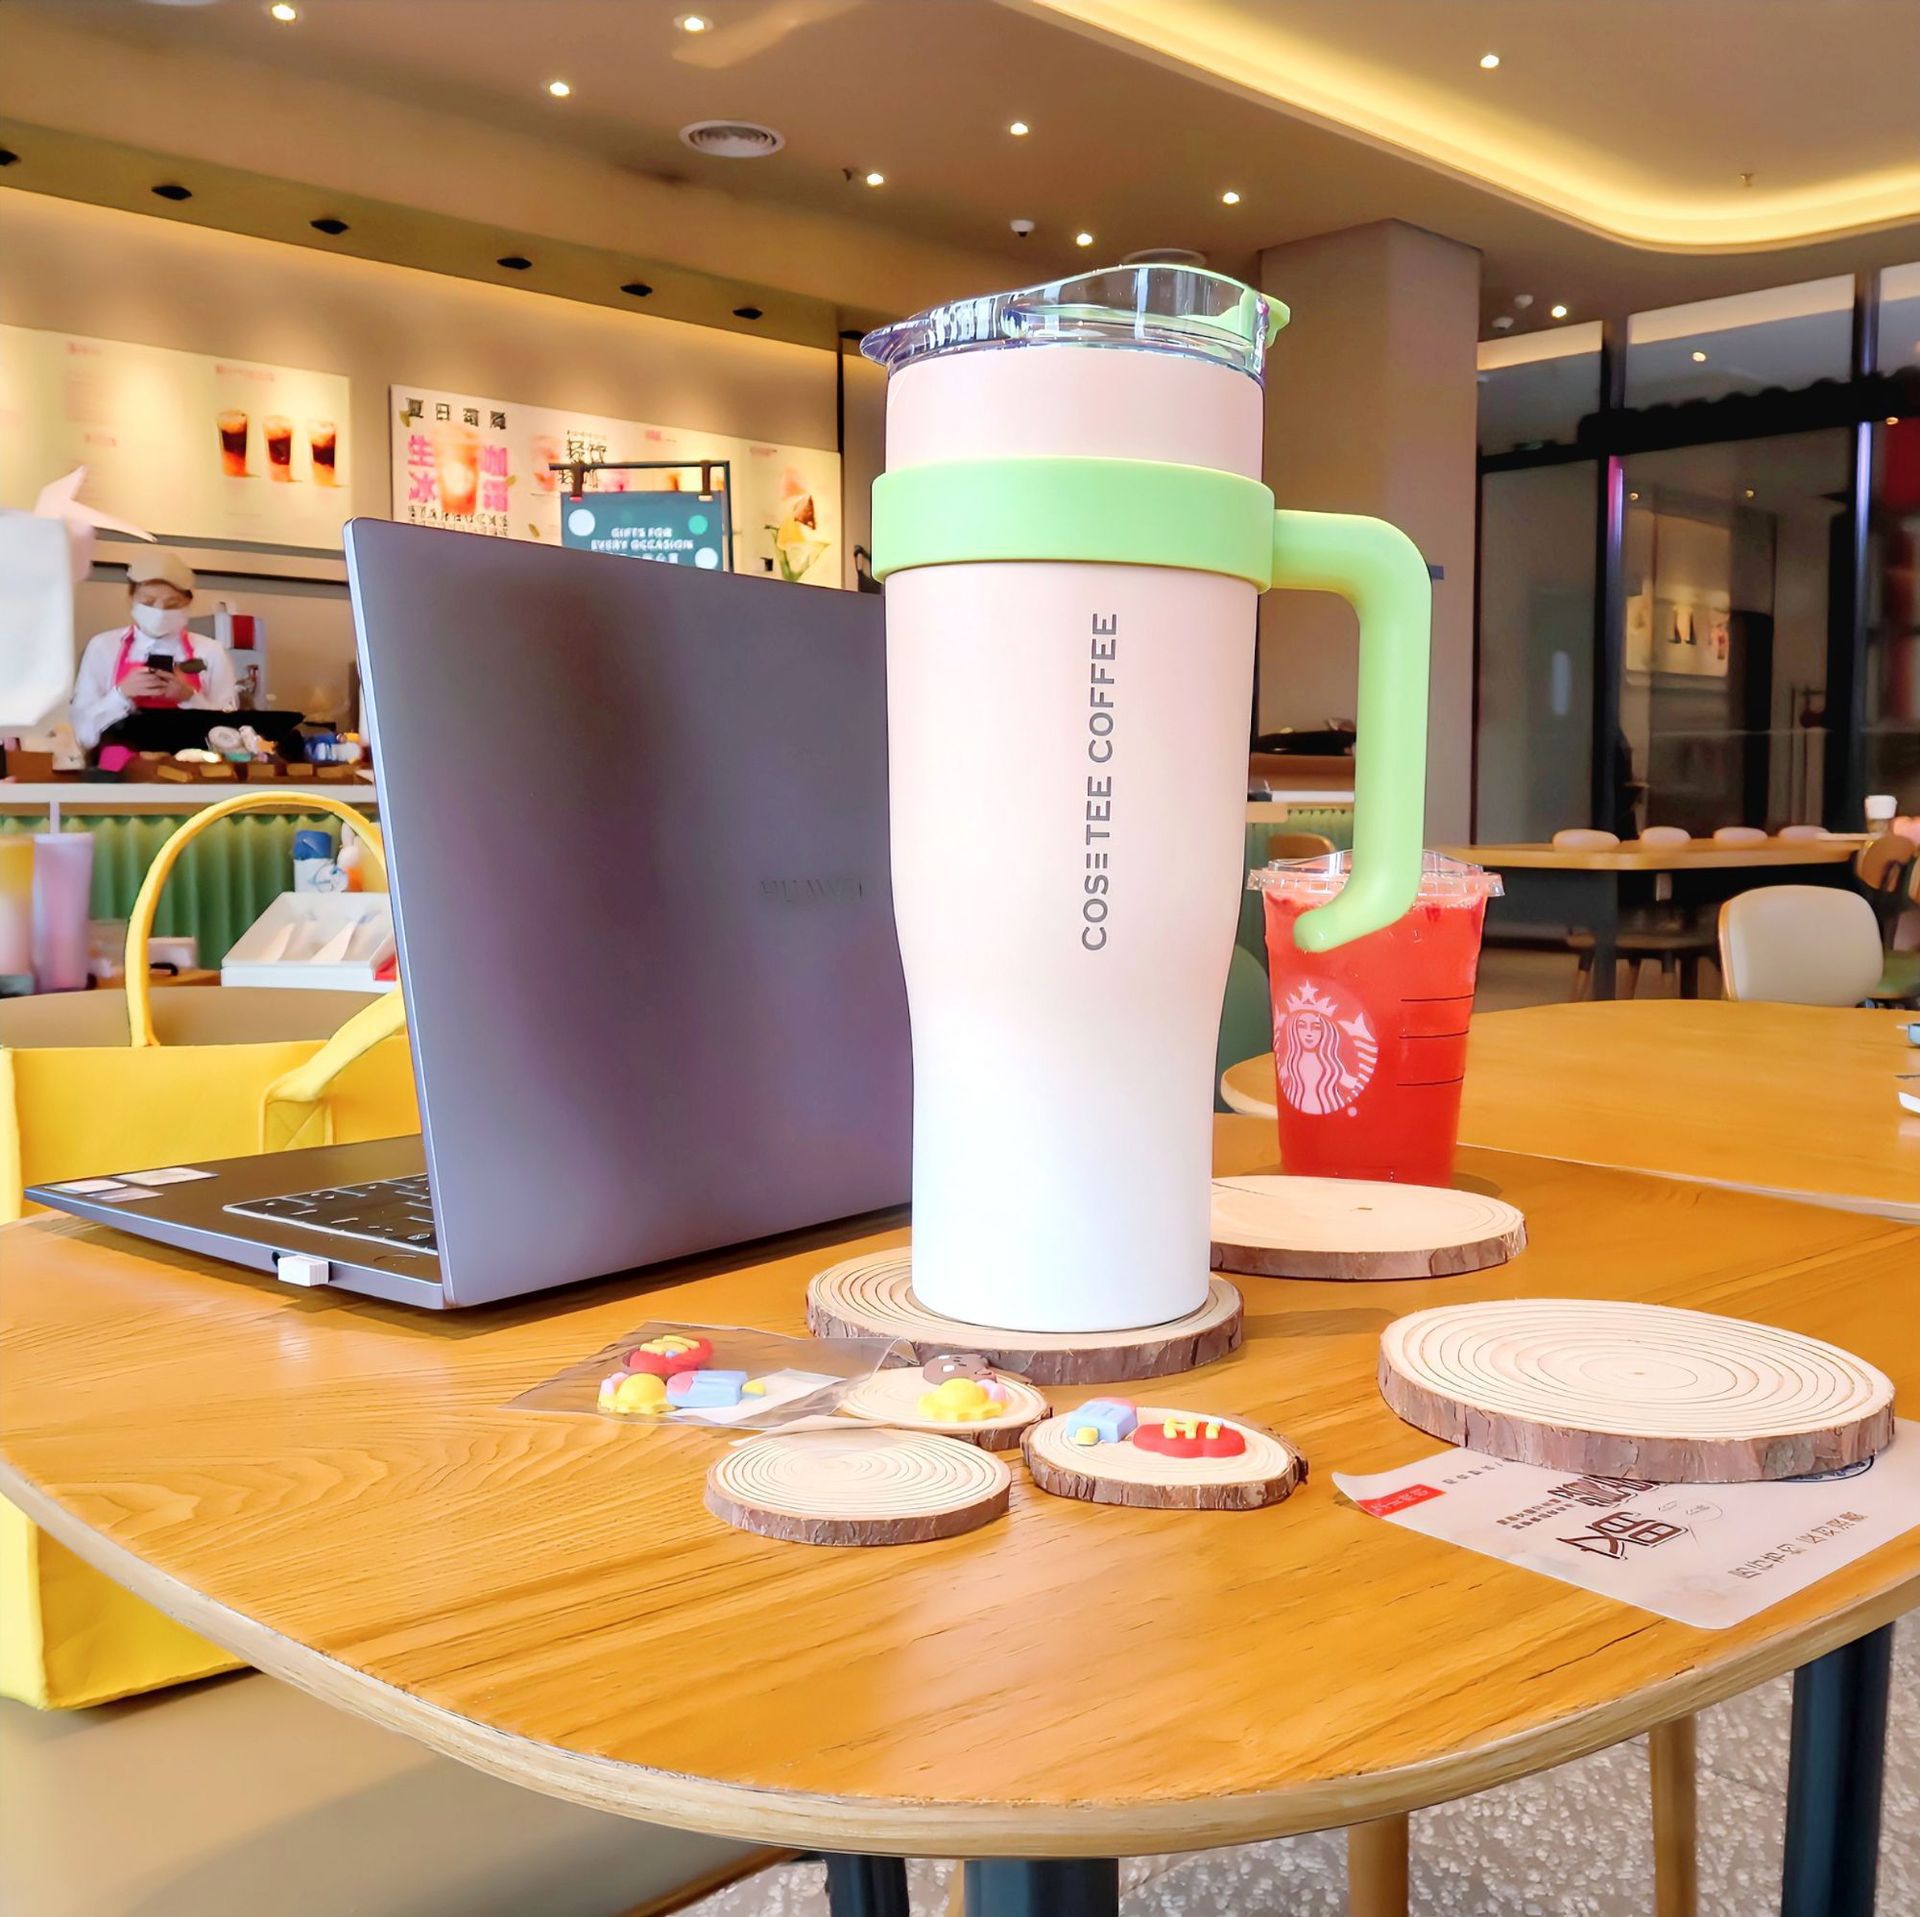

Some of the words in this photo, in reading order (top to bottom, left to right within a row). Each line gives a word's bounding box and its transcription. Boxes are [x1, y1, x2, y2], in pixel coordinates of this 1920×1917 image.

[590, 539, 628, 551] EVERY
[630, 539, 694, 551] OCCASION
[611, 527, 646, 538] GIFTS
[647, 527, 673, 539] FOR
[1088, 613, 1117, 763] COFFEE
[1555, 1511, 1688, 1560] 文明
